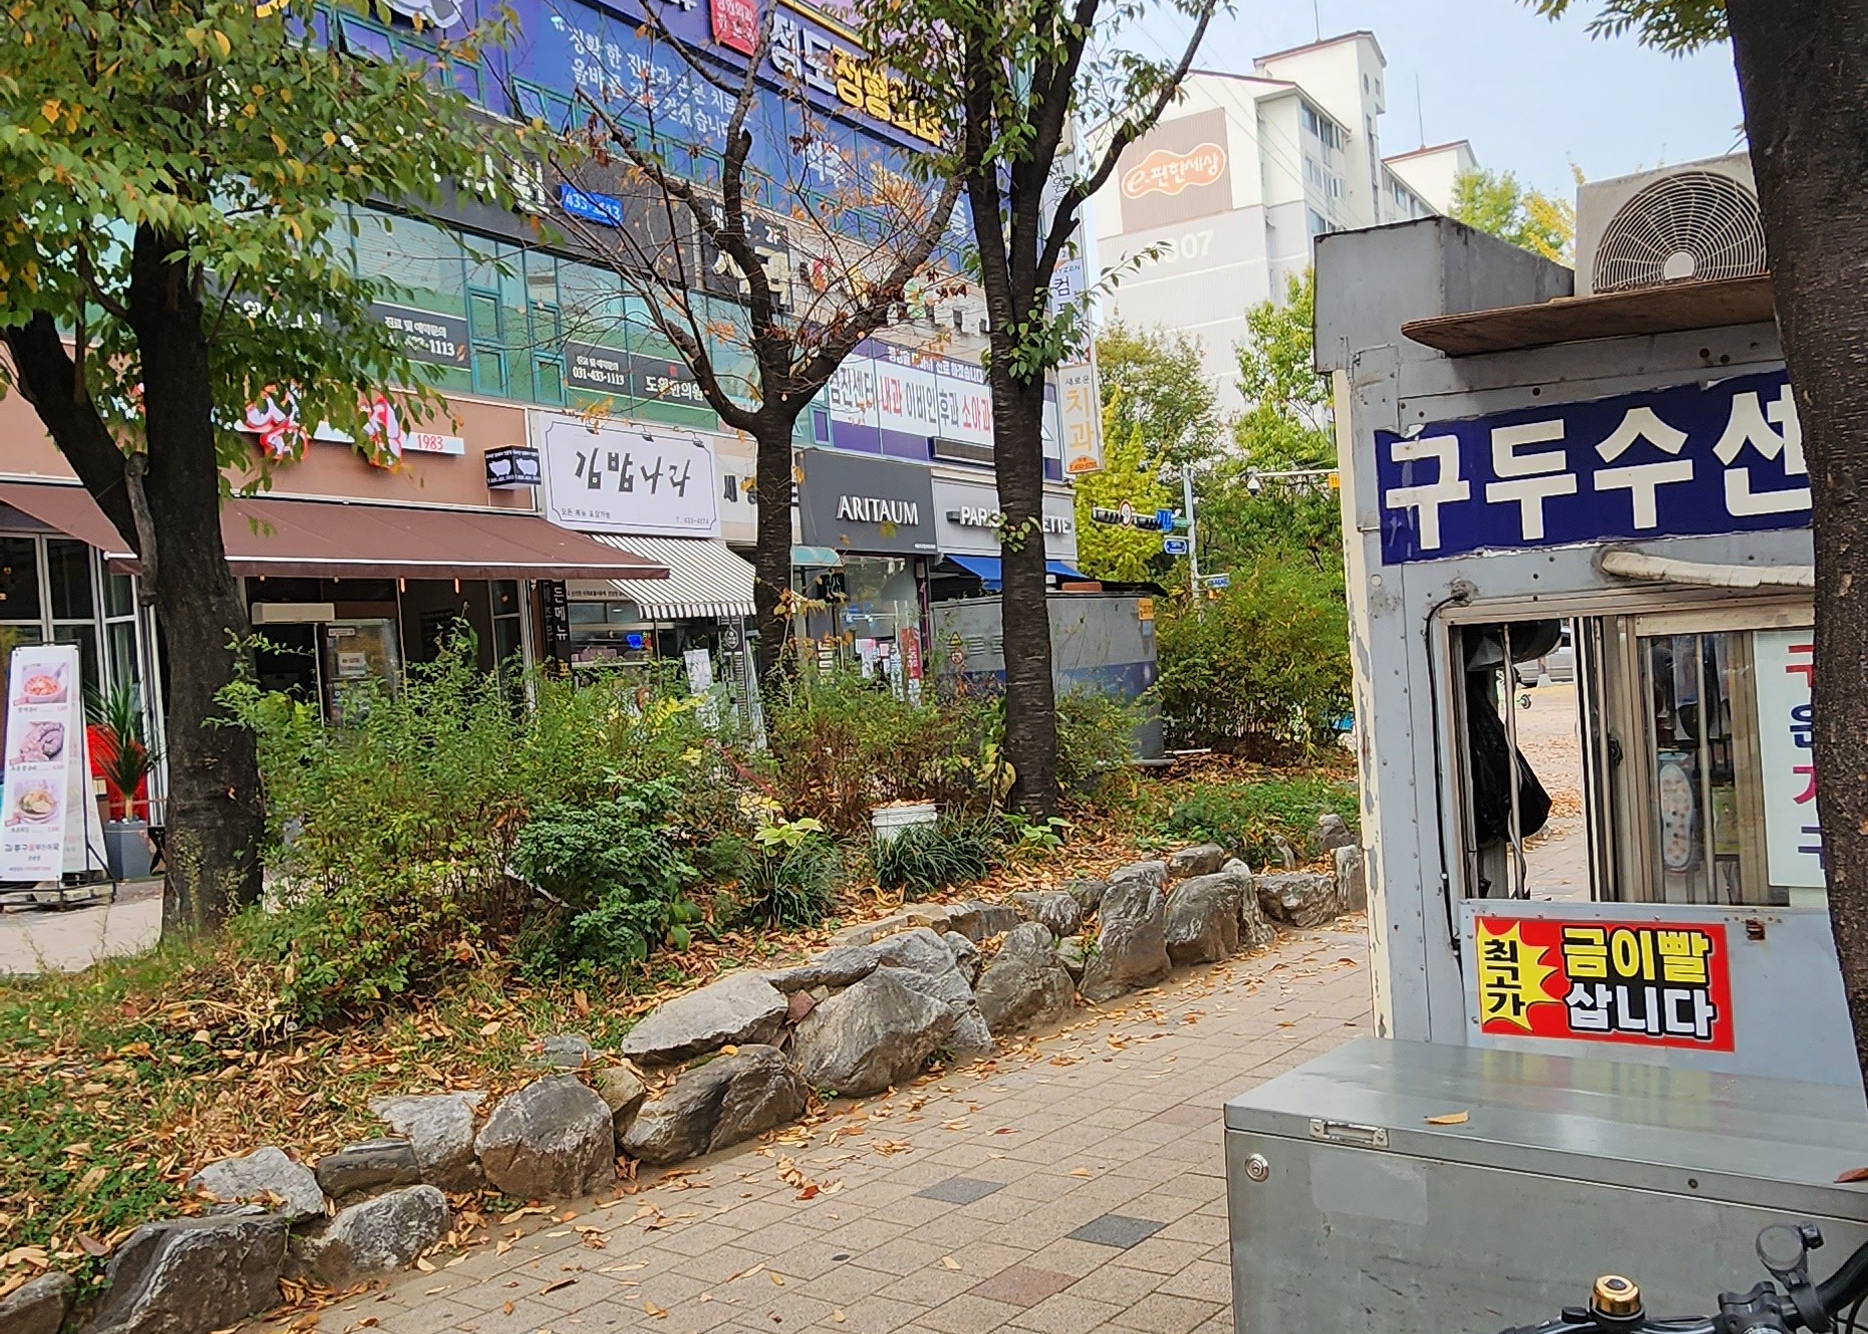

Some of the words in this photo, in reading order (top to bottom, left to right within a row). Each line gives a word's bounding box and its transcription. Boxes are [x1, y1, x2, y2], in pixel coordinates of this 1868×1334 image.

[1127, 152, 1220, 193] e-편한세상
[879, 375, 903, 417] 내과
[905, 381, 960, 428] 이비인후과
[1065, 375, 1090, 386] 새로운
[417, 434, 444, 451] 1983
[1065, 386, 1095, 453] 치과
[574, 447, 691, 497] 김밥나라
[1385, 383, 1813, 551] 구두수선
[837, 495, 919, 527] ARITAUM
[552, 578, 569, 642] 든메뉴
[1484, 938, 1526, 1017] 최고가
[1564, 927, 1710, 984] 금이빨
[1564, 982, 1715, 1037] 삽니다
